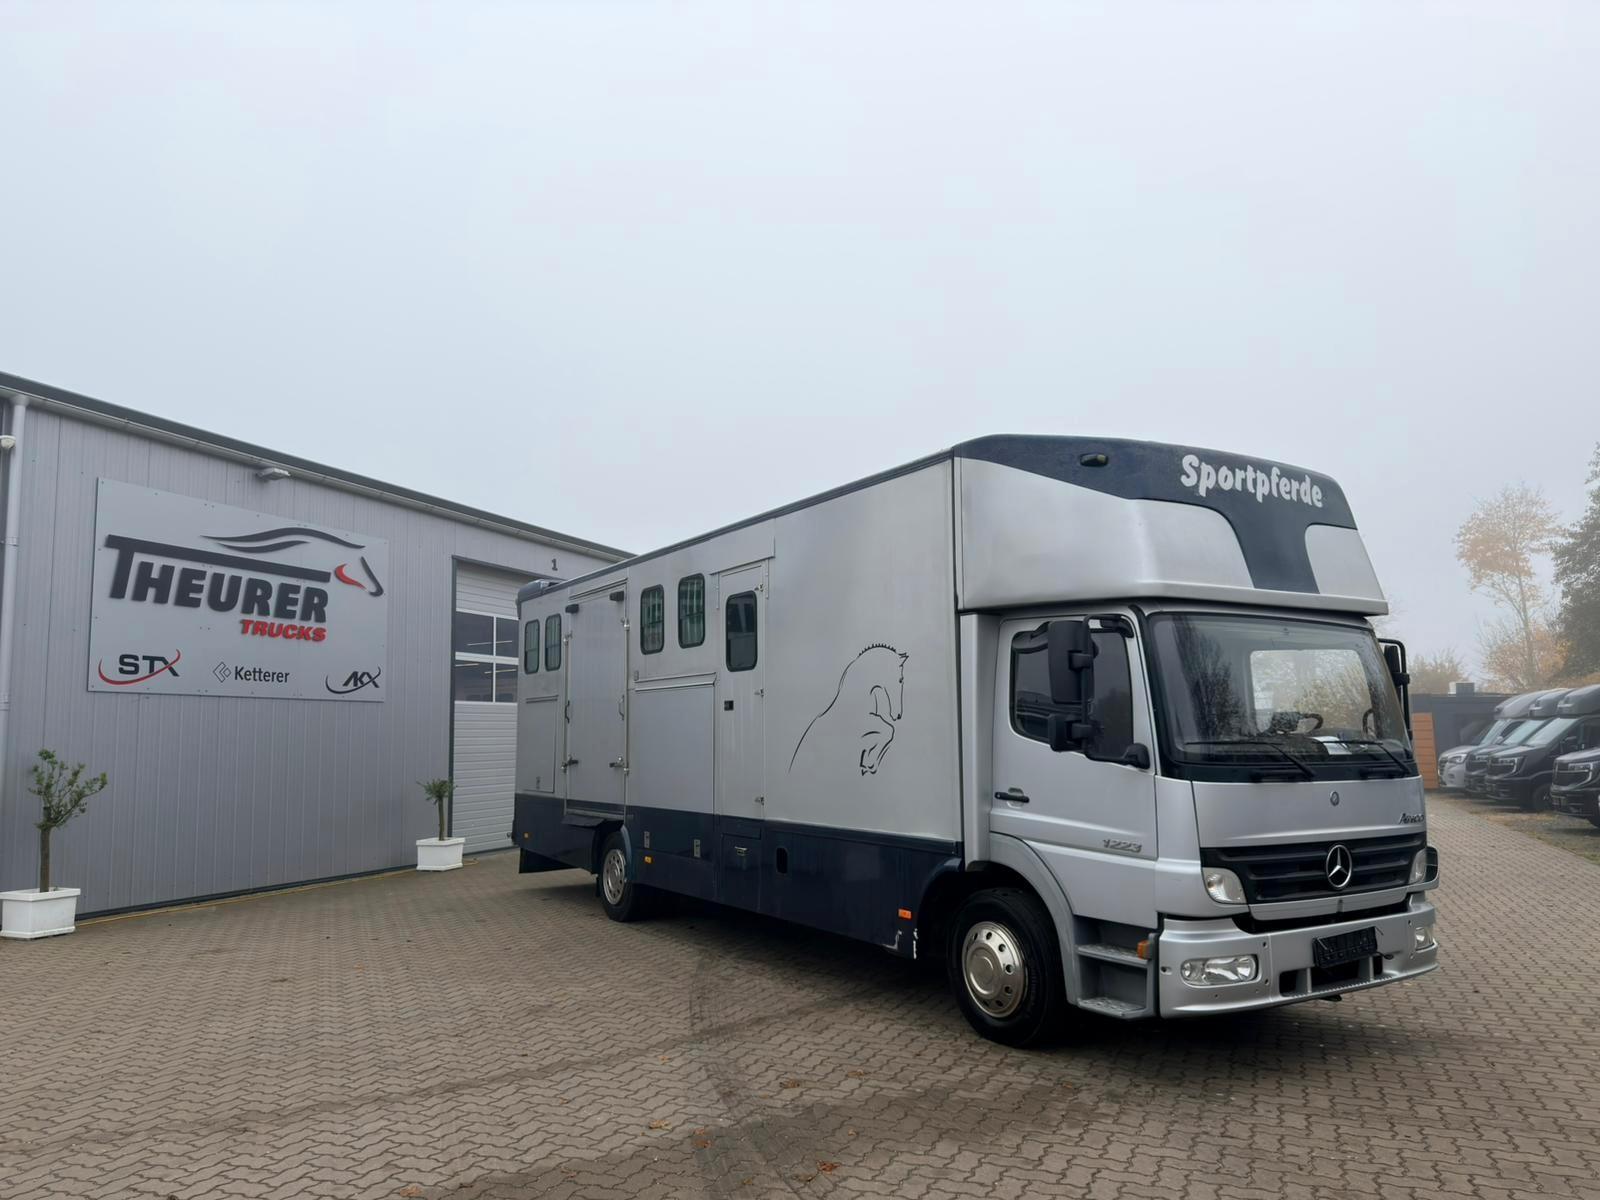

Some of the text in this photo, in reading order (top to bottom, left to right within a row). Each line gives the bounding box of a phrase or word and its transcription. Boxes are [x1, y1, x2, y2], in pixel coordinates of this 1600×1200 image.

[1181, 454, 1323, 508] Sportpferde
[551, 558, 558, 571] 1
[104, 534, 331, 623] THEURER
[240, 618, 327, 642] TRUCKS
[117, 651, 181, 678] STX
[234, 665, 290, 683] Ketterer
[1102, 839, 1142, 853] 1223
